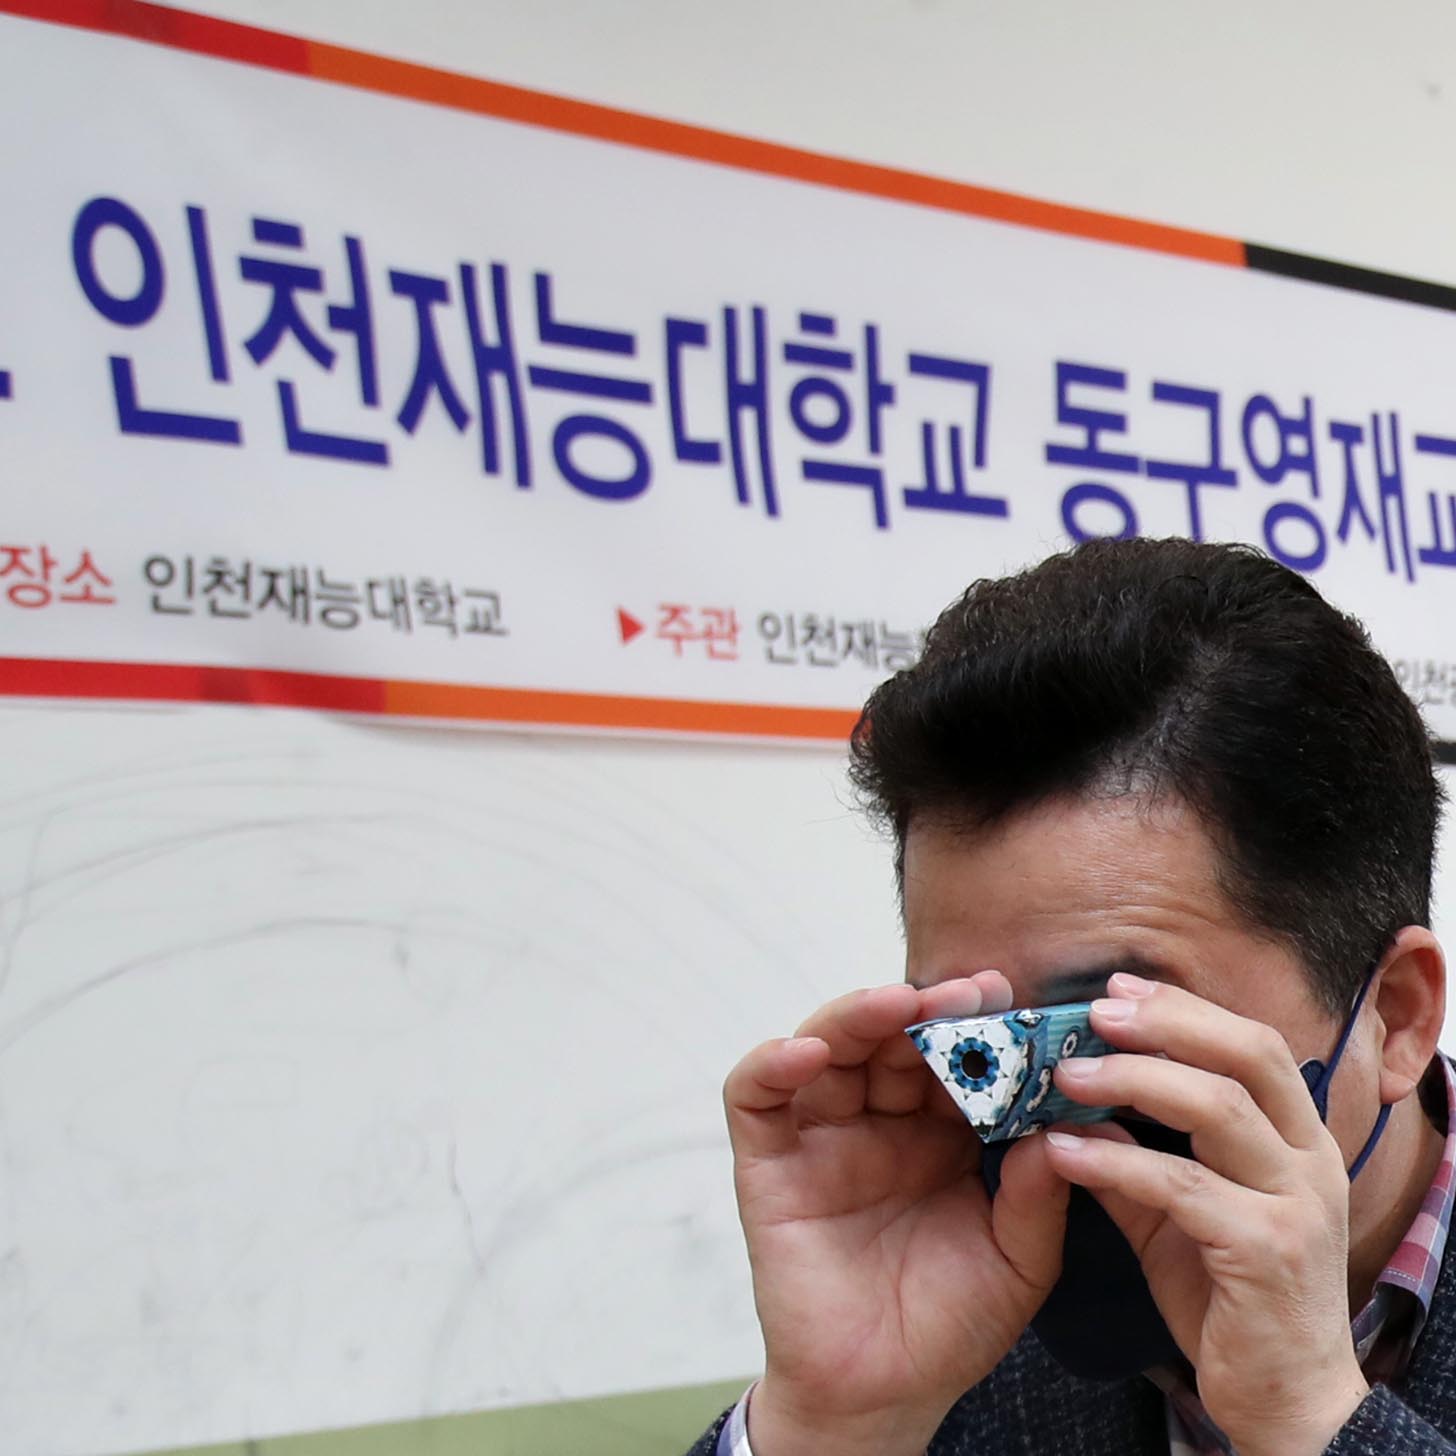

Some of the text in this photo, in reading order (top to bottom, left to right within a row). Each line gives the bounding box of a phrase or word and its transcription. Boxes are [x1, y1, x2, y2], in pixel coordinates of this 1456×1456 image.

[71, 196, 1009, 531] 인천재능대학교
[0, 543, 509, 639] 장소 인천재능대학교
[656, 602, 924, 672] 주관 인천재능
